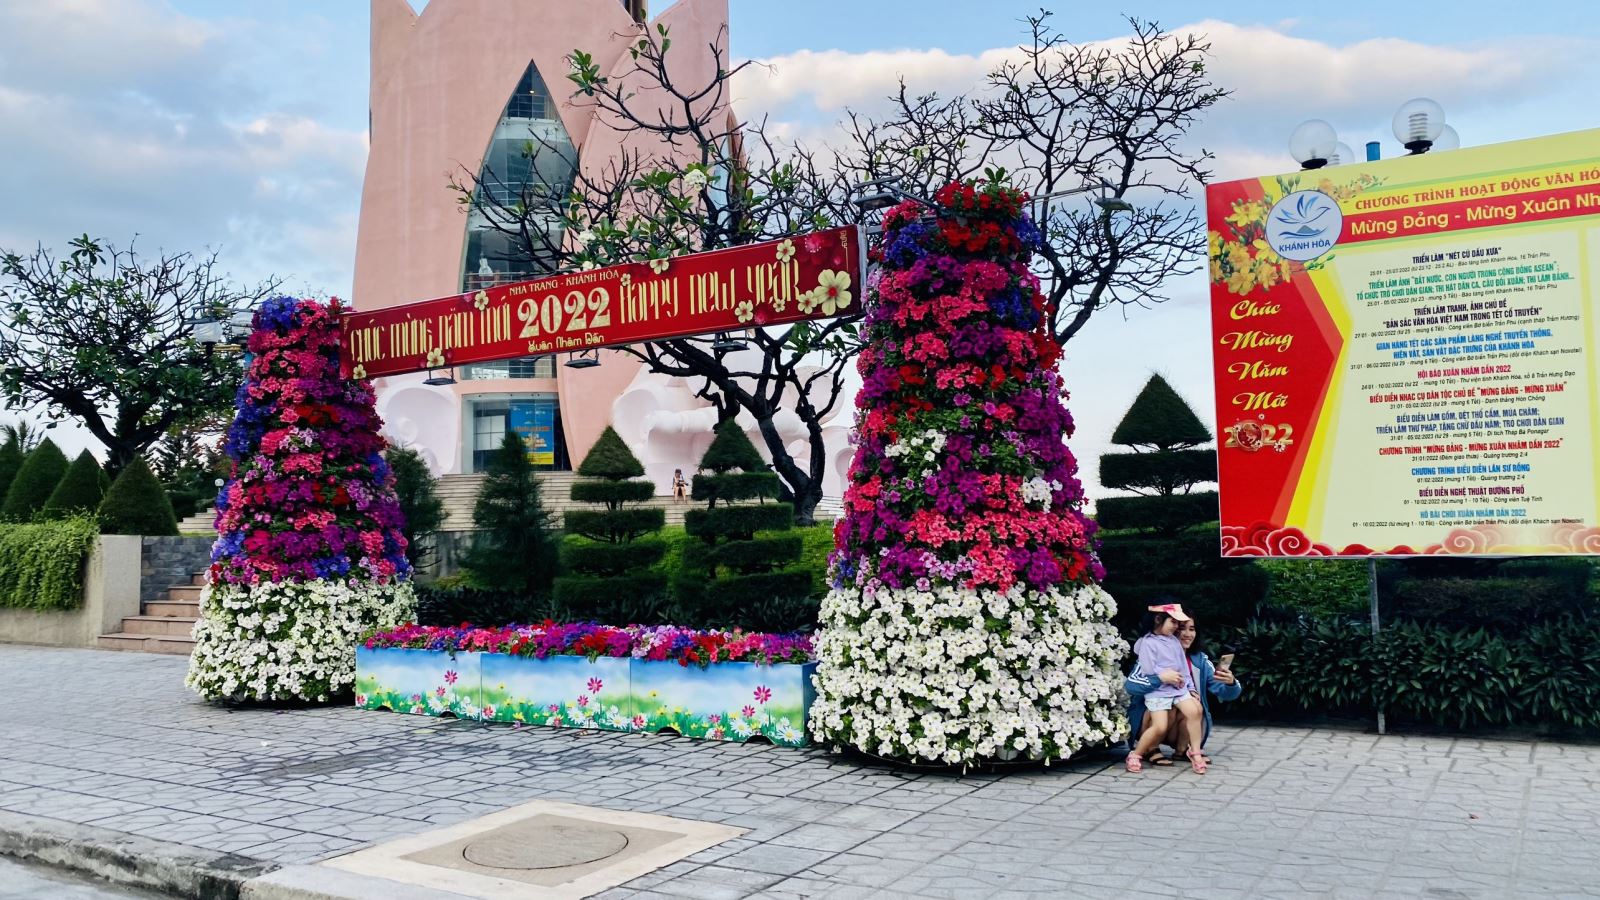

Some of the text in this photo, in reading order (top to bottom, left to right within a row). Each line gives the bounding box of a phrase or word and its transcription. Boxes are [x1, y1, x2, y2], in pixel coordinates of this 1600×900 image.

[1355, 194, 1409, 210] CHƯƠNG
[1413, 188, 1455, 203] TRÌNH
[1459, 183, 1496, 198] HOẠT
[1501, 178, 1541, 194] ĐỘNG
[1544, 171, 1575, 187] VĂN
[1351, 216, 1397, 236] Mừng
[1403, 210, 1449, 230] Đảng
[1466, 203, 1517, 222] Mừng
[1521, 197, 1571, 215] Xuân
[1279, 239, 1331, 252] KHÁNH HÒA
[509, 267, 619, 297] NHA TRANG KHÁNH HÒA
[517, 287, 611, 339] 2022
[1229, 299, 1282, 321] Chúc
[1219, 330, 1294, 353] Mừng
[1227, 360, 1289, 381] Năm
[1231, 391, 1289, 411] Mới
